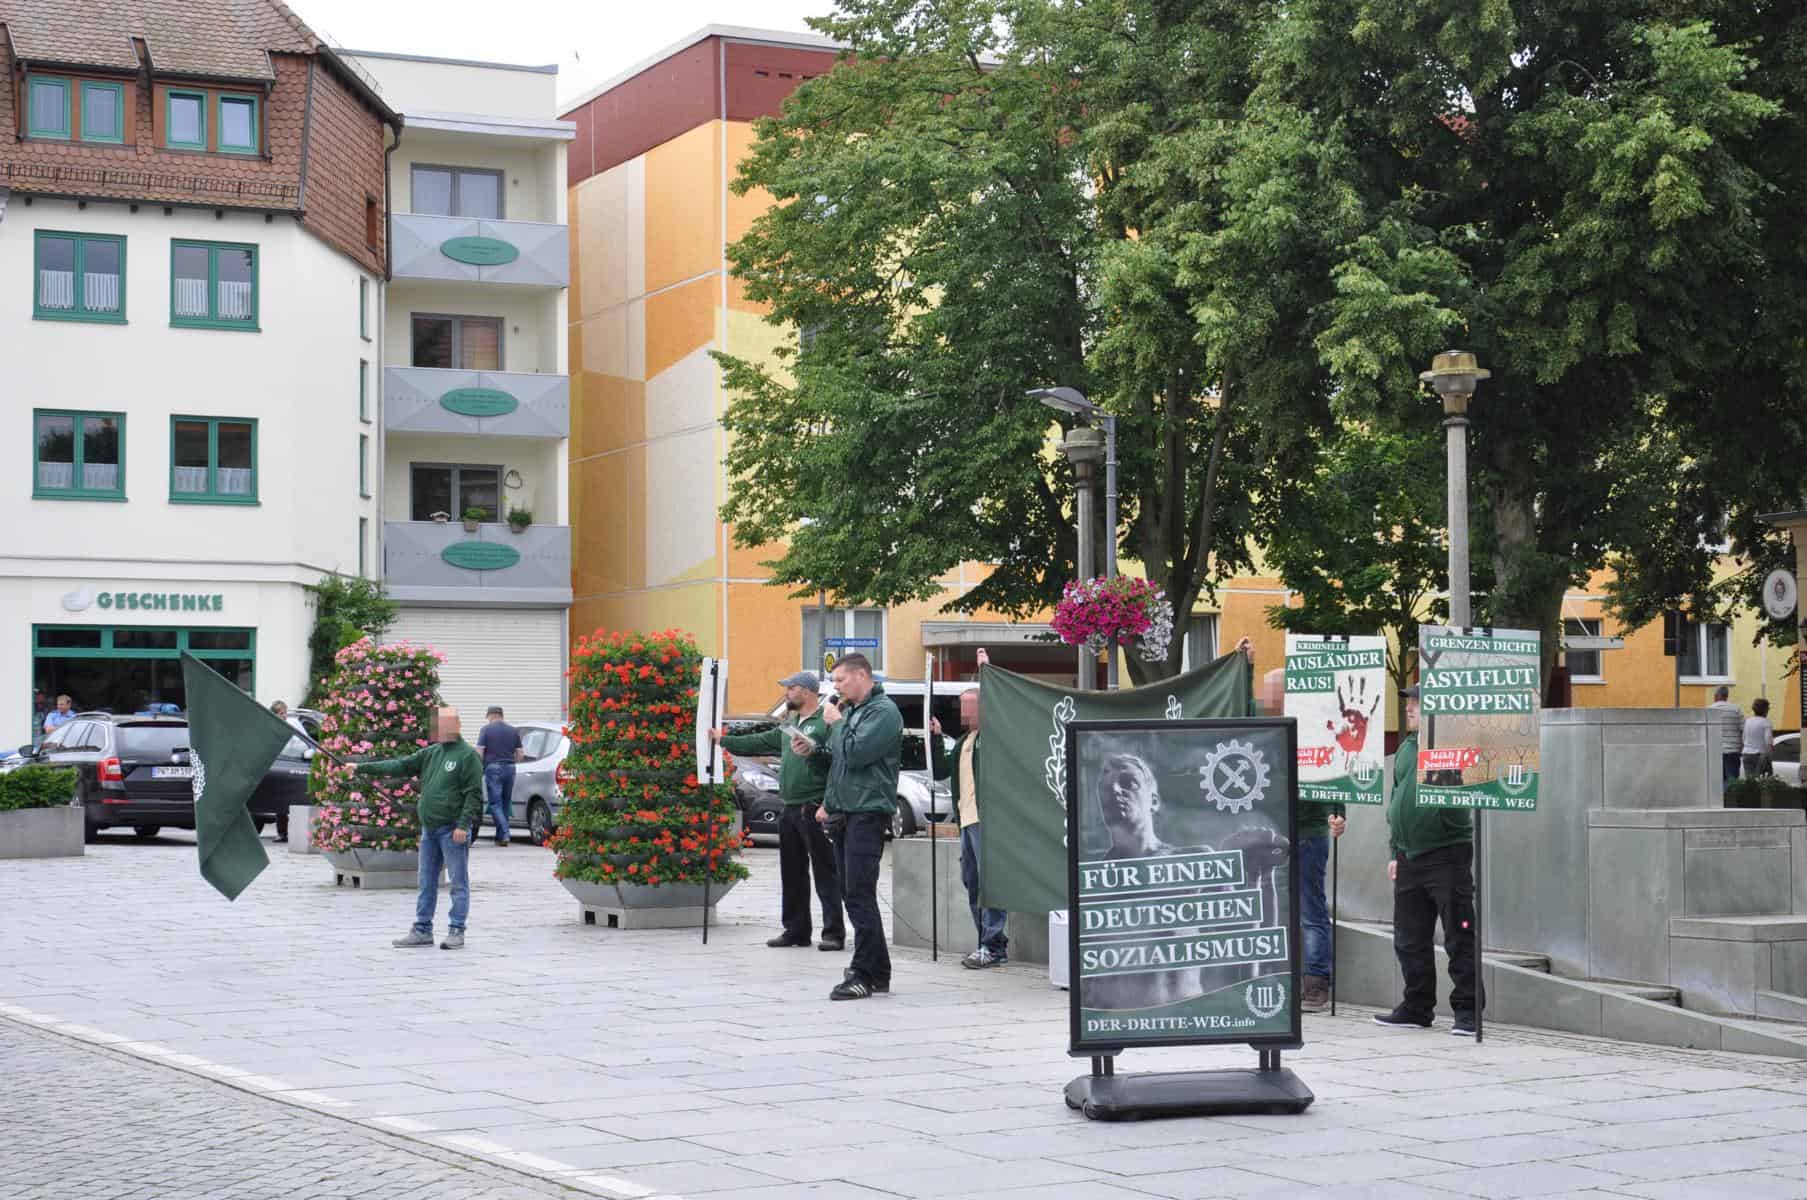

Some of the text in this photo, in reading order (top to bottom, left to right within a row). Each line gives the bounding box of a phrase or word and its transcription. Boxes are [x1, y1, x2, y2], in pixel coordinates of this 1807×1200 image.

[96, 591, 224, 612] GESCHENKE
[1430, 637, 1537, 653] GRENZEN DICHT!
[1287, 652, 1381, 671] AUSLÄNDER
[1287, 675, 1332, 690] RAUS!
[1423, 668, 1535, 689] ASYLFLUT
[1423, 693, 1530, 711] STOPPEN!
[1312, 790, 1352, 801] DRITTE
[1356, 792, 1382, 802] WEG
[1420, 794, 1535, 809] DER DRITTE WEG
[1083, 858, 1235, 889] FÜR EINEN
[1084, 897, 1256, 930] DEUTSCHEN
[1083, 935, 1281, 970] SOZIALISMUS!
[1087, 1014, 1256, 1033] DER-DRITTE-WEG.info
